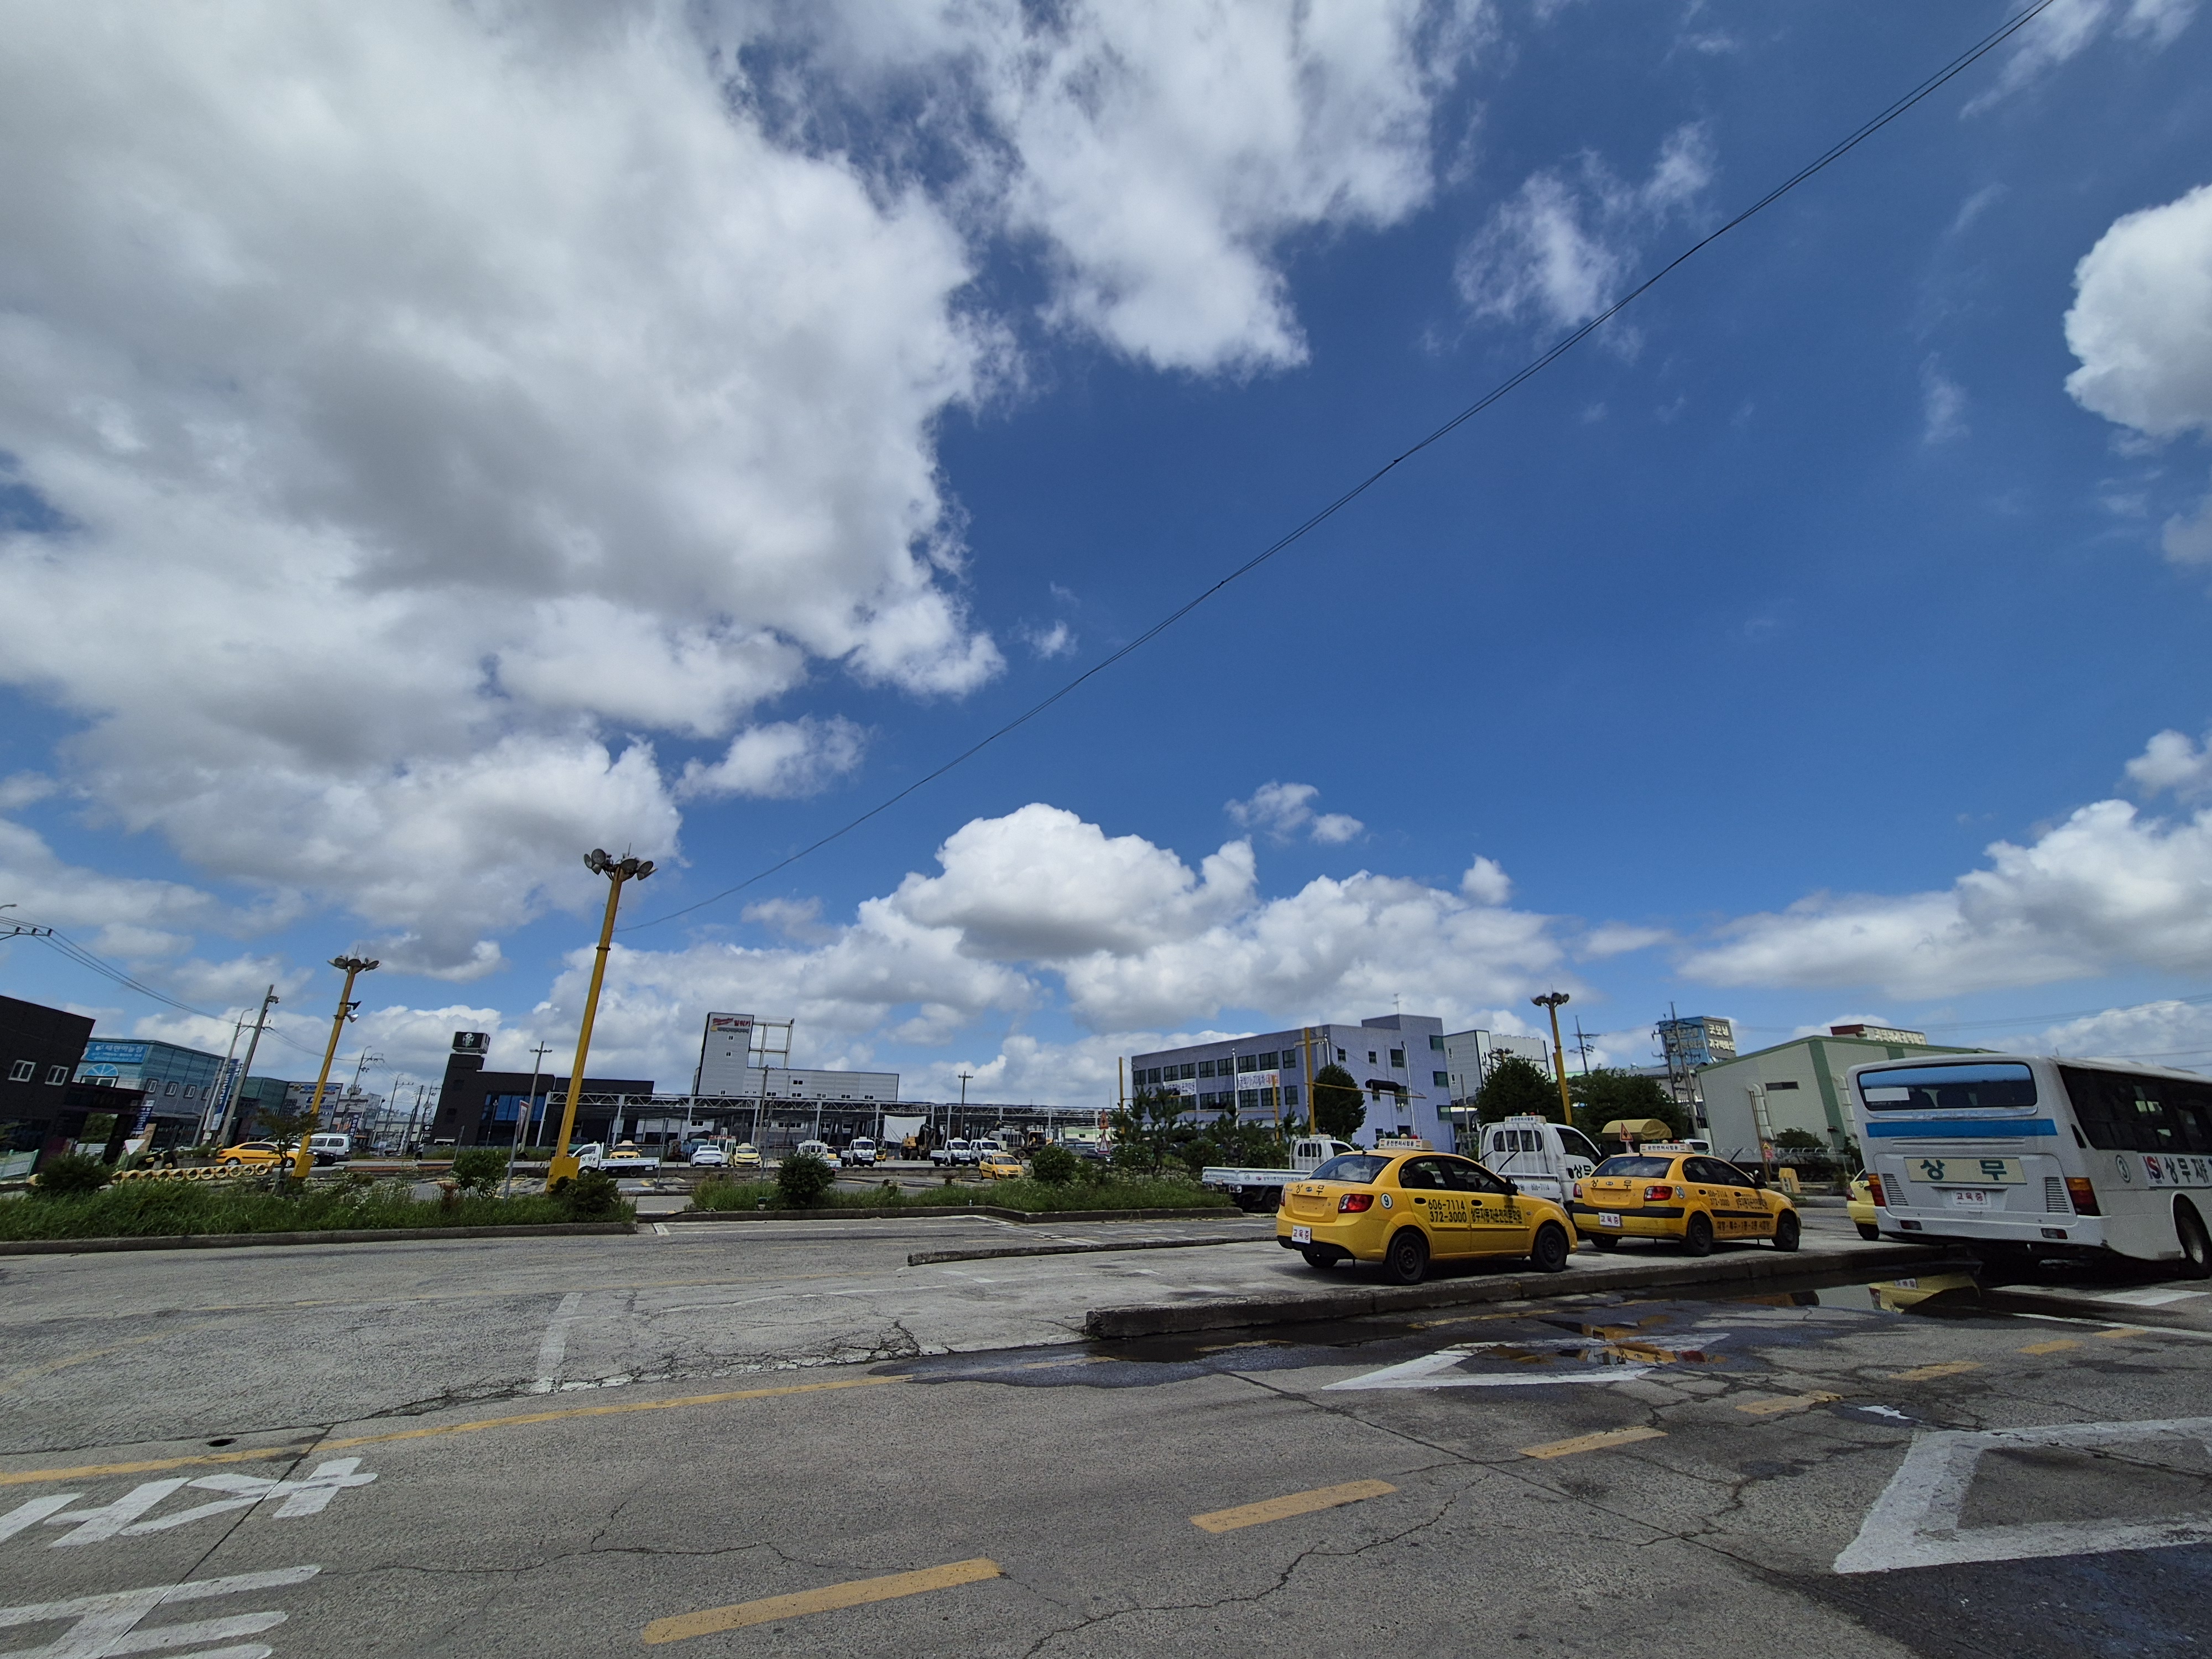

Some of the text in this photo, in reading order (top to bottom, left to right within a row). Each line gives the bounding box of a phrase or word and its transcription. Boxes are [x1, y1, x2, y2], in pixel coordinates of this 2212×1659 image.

[1708, 1024, 1729, 1036] 굿모닝
[1920, 1159, 1945, 1180] 상
[1979, 1160, 2007, 1181] 무
[1428, 1199, 1465, 1211] 606-7114
[1430, 1211, 1467, 1223] 372-3000
